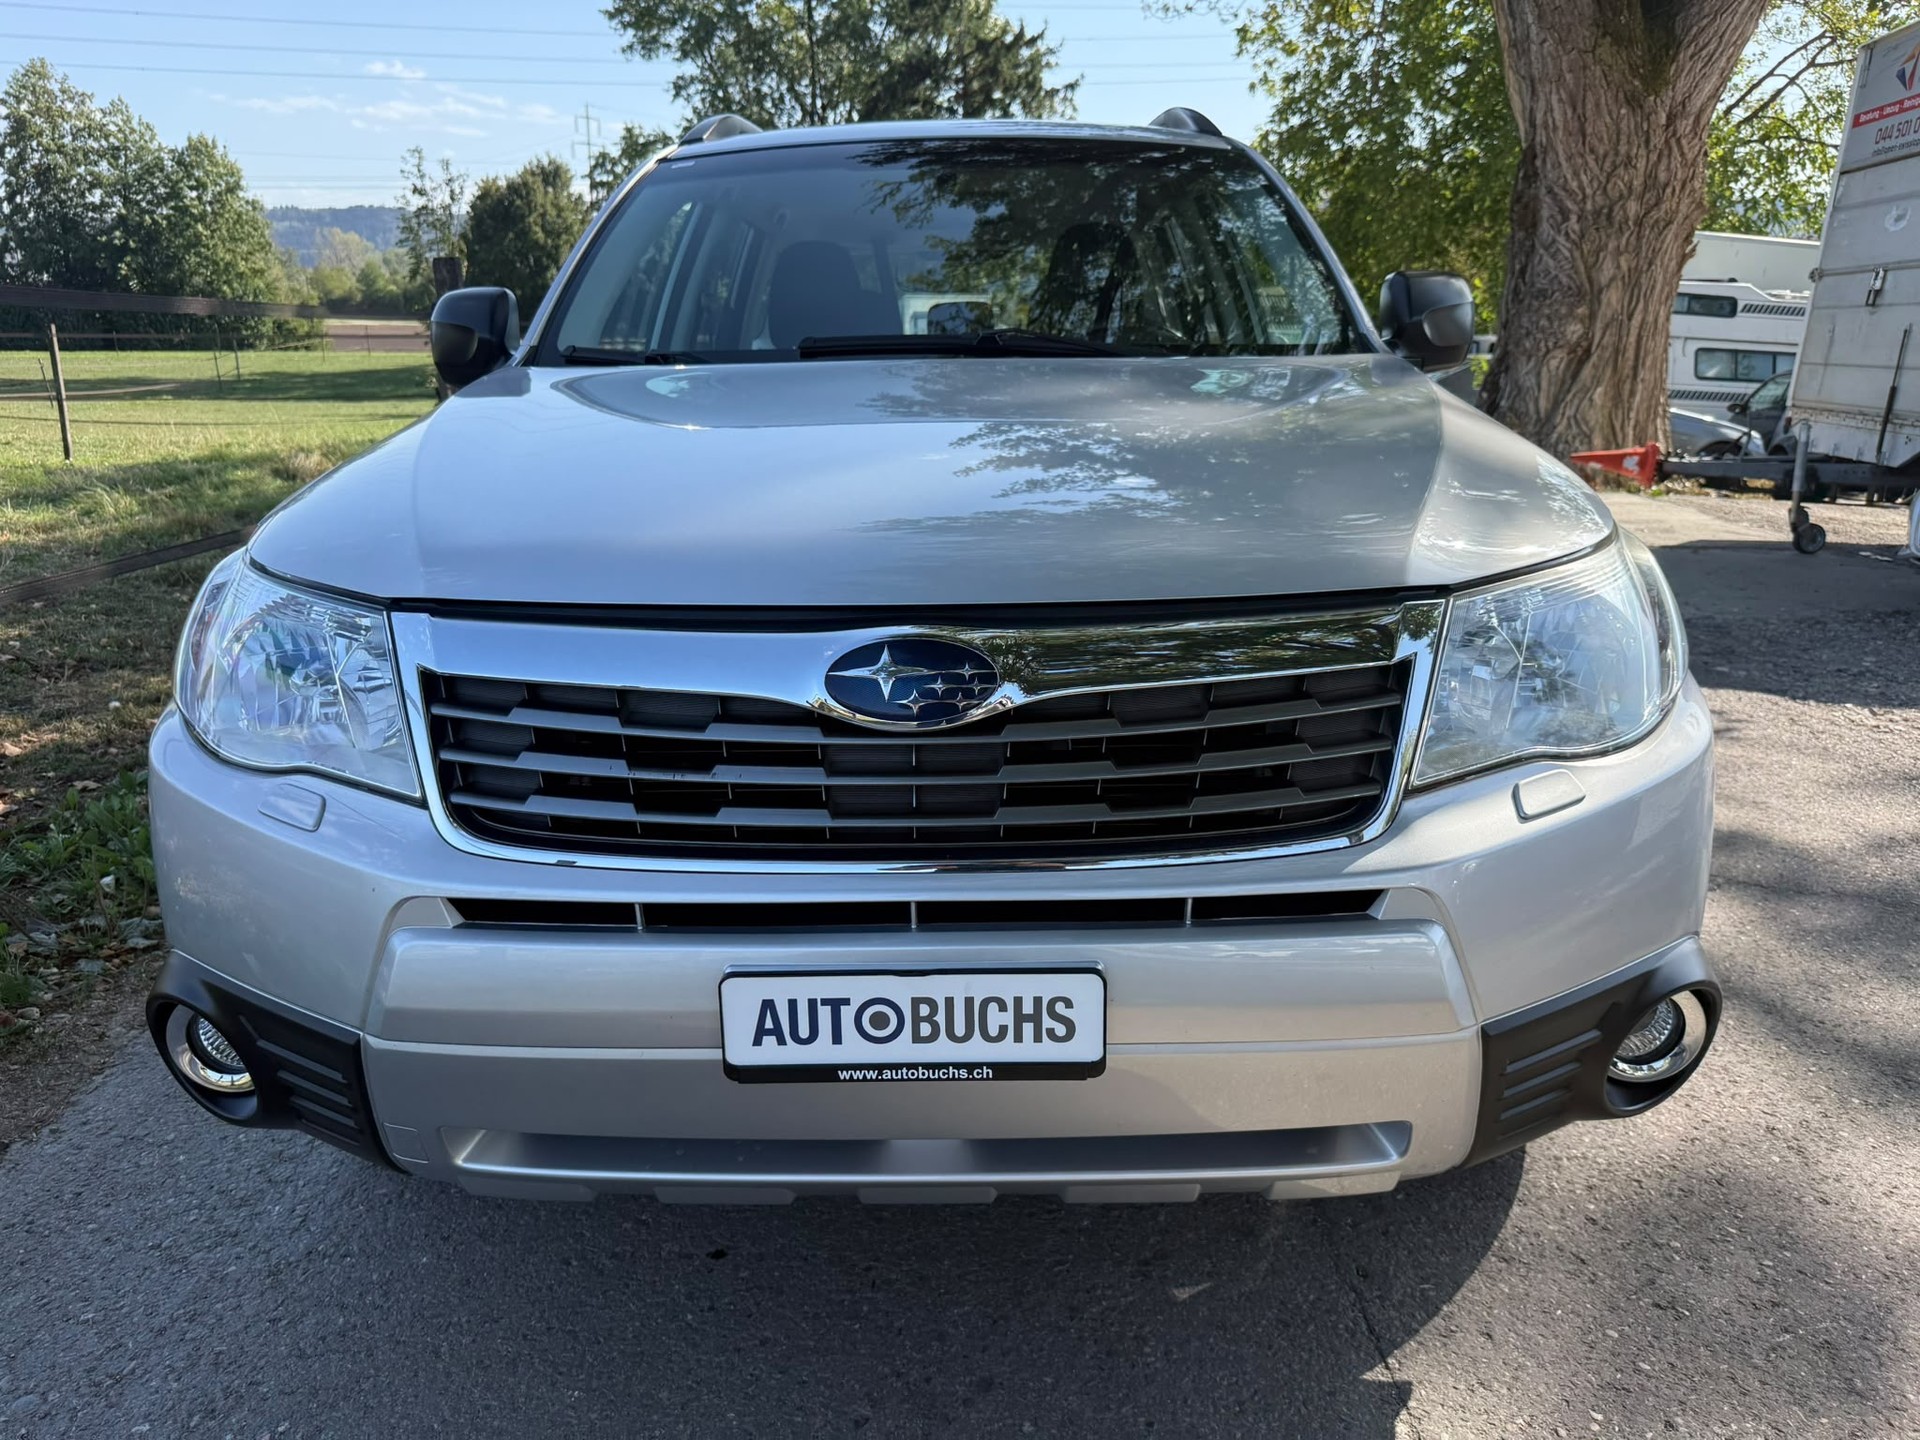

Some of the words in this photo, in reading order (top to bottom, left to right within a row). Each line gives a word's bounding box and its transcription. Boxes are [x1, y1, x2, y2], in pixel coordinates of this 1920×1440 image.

[1875, 124, 1894, 145] 044
[1895, 119, 1912, 139] 501
[751, 995, 1076, 1047] AUTOBUCHS
[838, 1065, 993, 1082] www.autobuchs.ch
